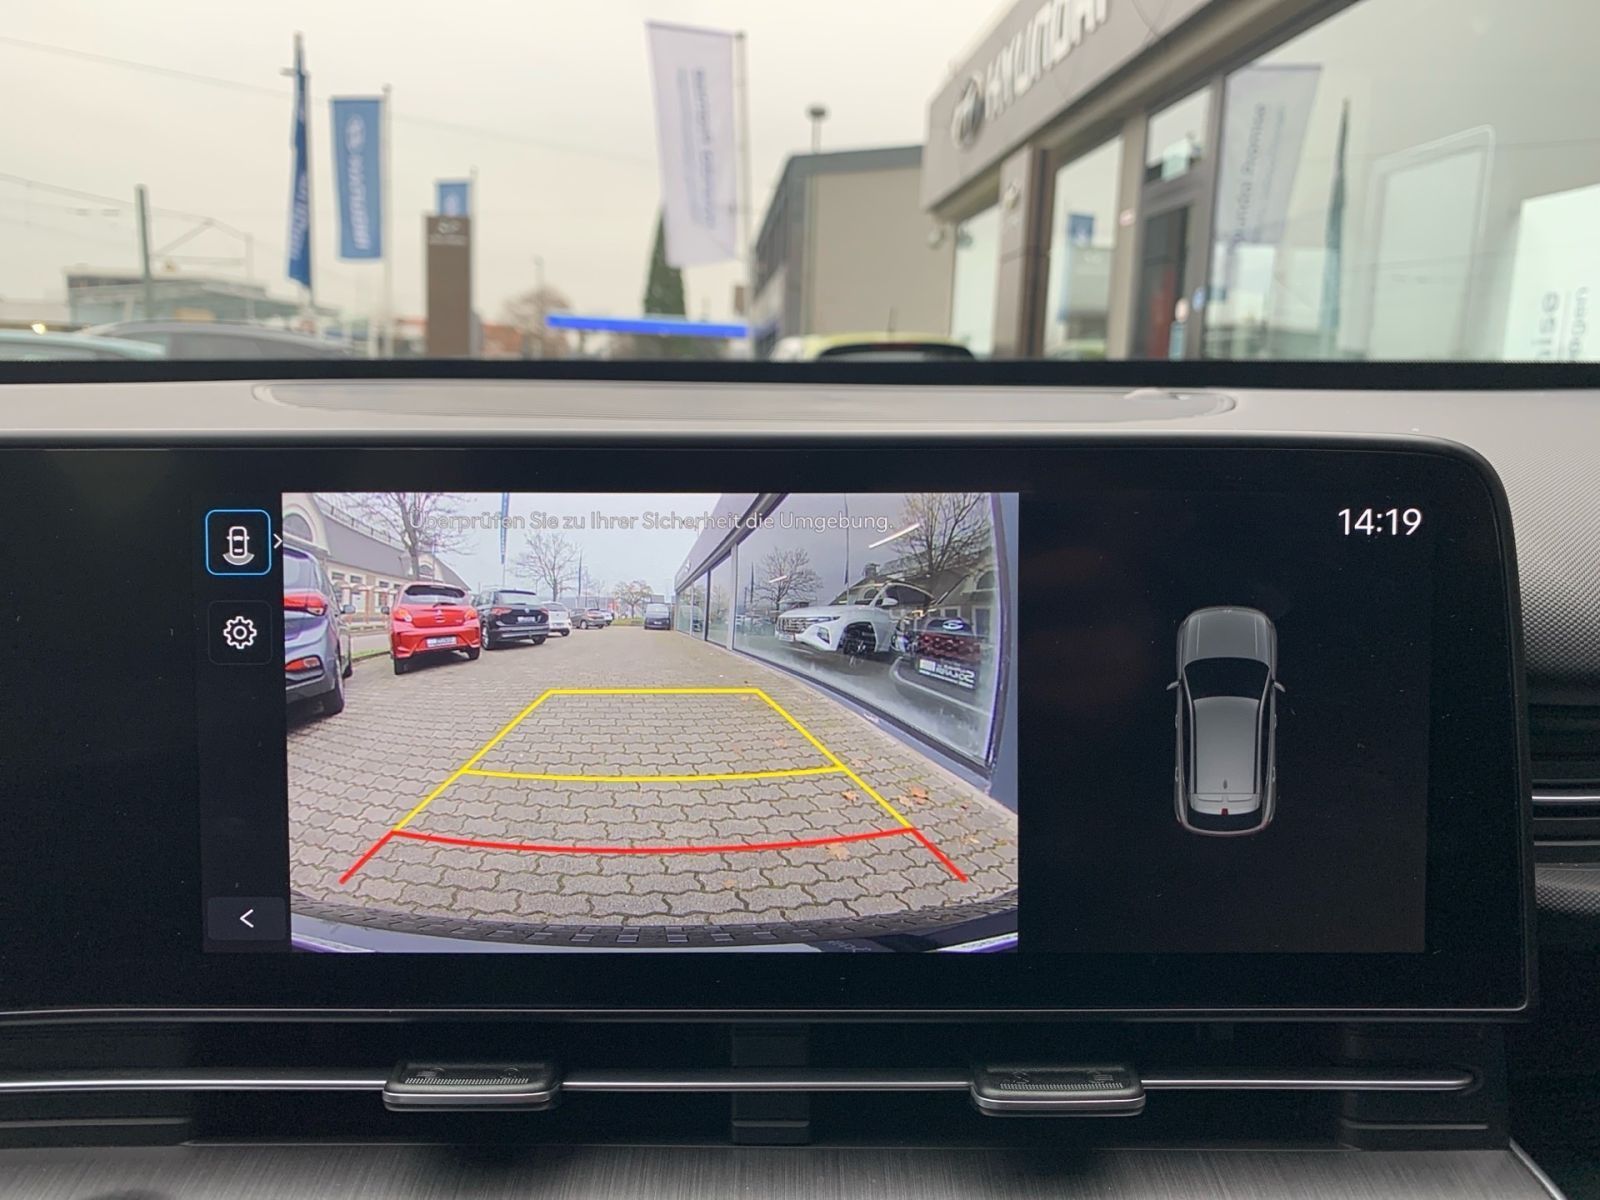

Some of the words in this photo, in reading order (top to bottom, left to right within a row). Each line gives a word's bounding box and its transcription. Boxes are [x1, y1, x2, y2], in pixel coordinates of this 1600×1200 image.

[410, 509, 525, 533] Überprüfen
[529, 511, 558, 529] Sie
[563, 514, 585, 529] zu
[590, 511, 639, 529] Ihrer
[642, 511, 741, 530] Sicherheit
[745, 511, 775, 529] die
[779, 511, 894, 533] Umgebung.
[1338, 508, 1422, 536] 14:19
